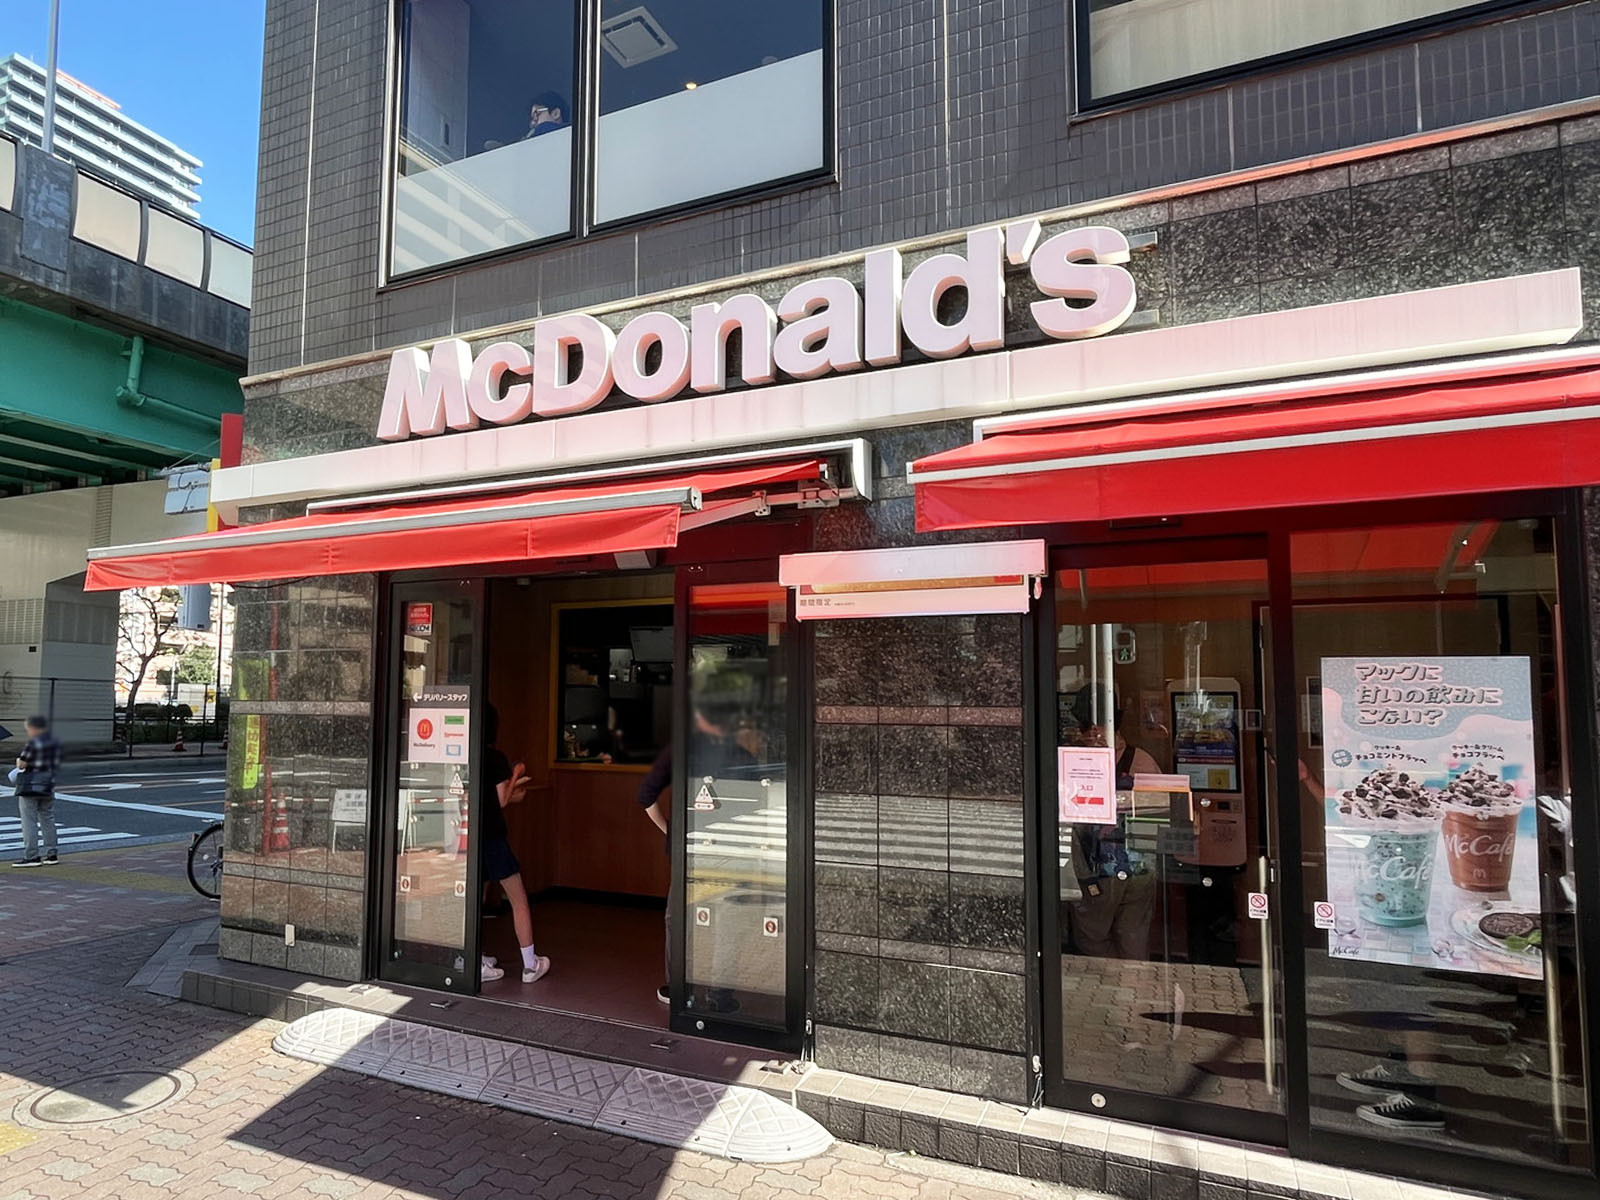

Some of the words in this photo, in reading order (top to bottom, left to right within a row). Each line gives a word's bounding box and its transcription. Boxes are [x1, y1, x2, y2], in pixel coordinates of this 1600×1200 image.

[376, 219, 1137, 441] McDonald's
[1355, 663, 1441, 682] マックに
[423, 693, 468, 702] デリバリースタッフ
[1356, 685, 1501, 705] 甘いの飲みに
